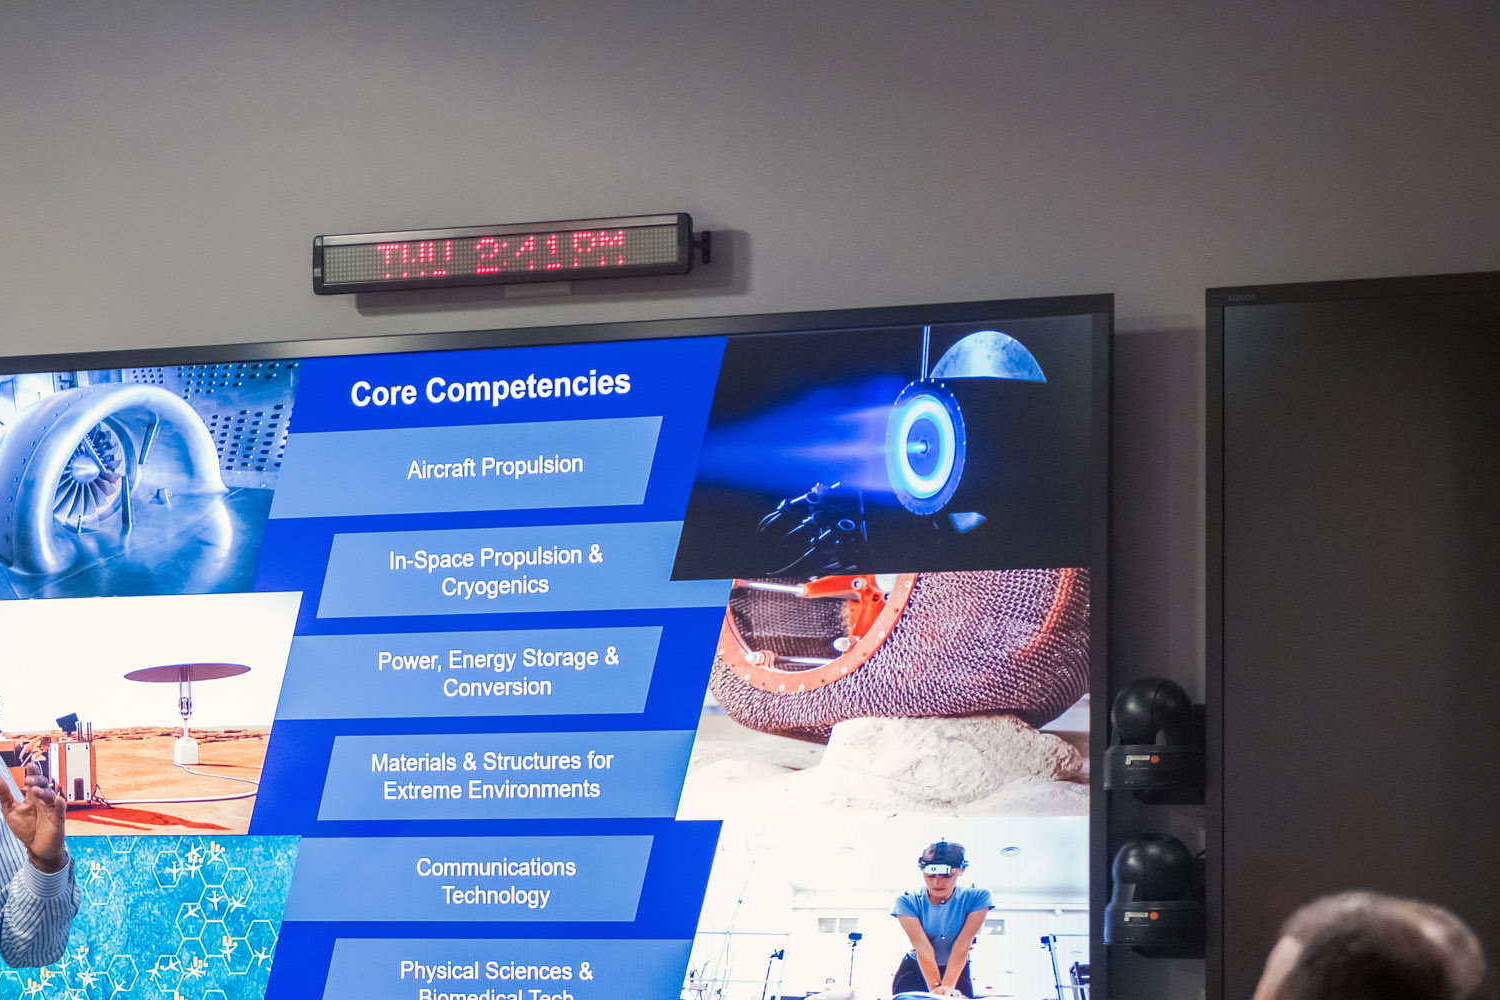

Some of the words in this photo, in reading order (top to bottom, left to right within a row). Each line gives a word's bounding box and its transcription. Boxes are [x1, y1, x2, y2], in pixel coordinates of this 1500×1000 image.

[376, 241, 452, 279] THU
[351, 381, 417, 407] Core
[426, 369, 631, 407] Competencies
[407, 458, 476, 480] Aircraft
[481, 454, 584, 480] Propulsion
[390, 550, 475, 574] In-Space
[480, 545, 583, 571] Propulsion
[588, 543, 604, 563] &
[441, 574, 550, 600] Cryogenics
[378, 651, 442, 673] Power,
[449, 649, 517, 673] Energy
[522, 647, 599, 671] Storage
[604, 646, 620, 665] &
[443, 676, 552, 697] Conversion
[371, 752, 457, 773] Materials
[462, 751, 477, 771] &
[483, 751, 582, 771] Structures
[586, 750, 615, 769] for
[384, 780, 463, 800] Extreme
[468, 779, 601, 799] Environments
[416, 857, 577, 877] Communications
[441, 885, 551, 909] Technology
[400, 960, 479, 984] Physical
[485, 961, 573, 981] Sciences
[578, 961, 594, 981] &
